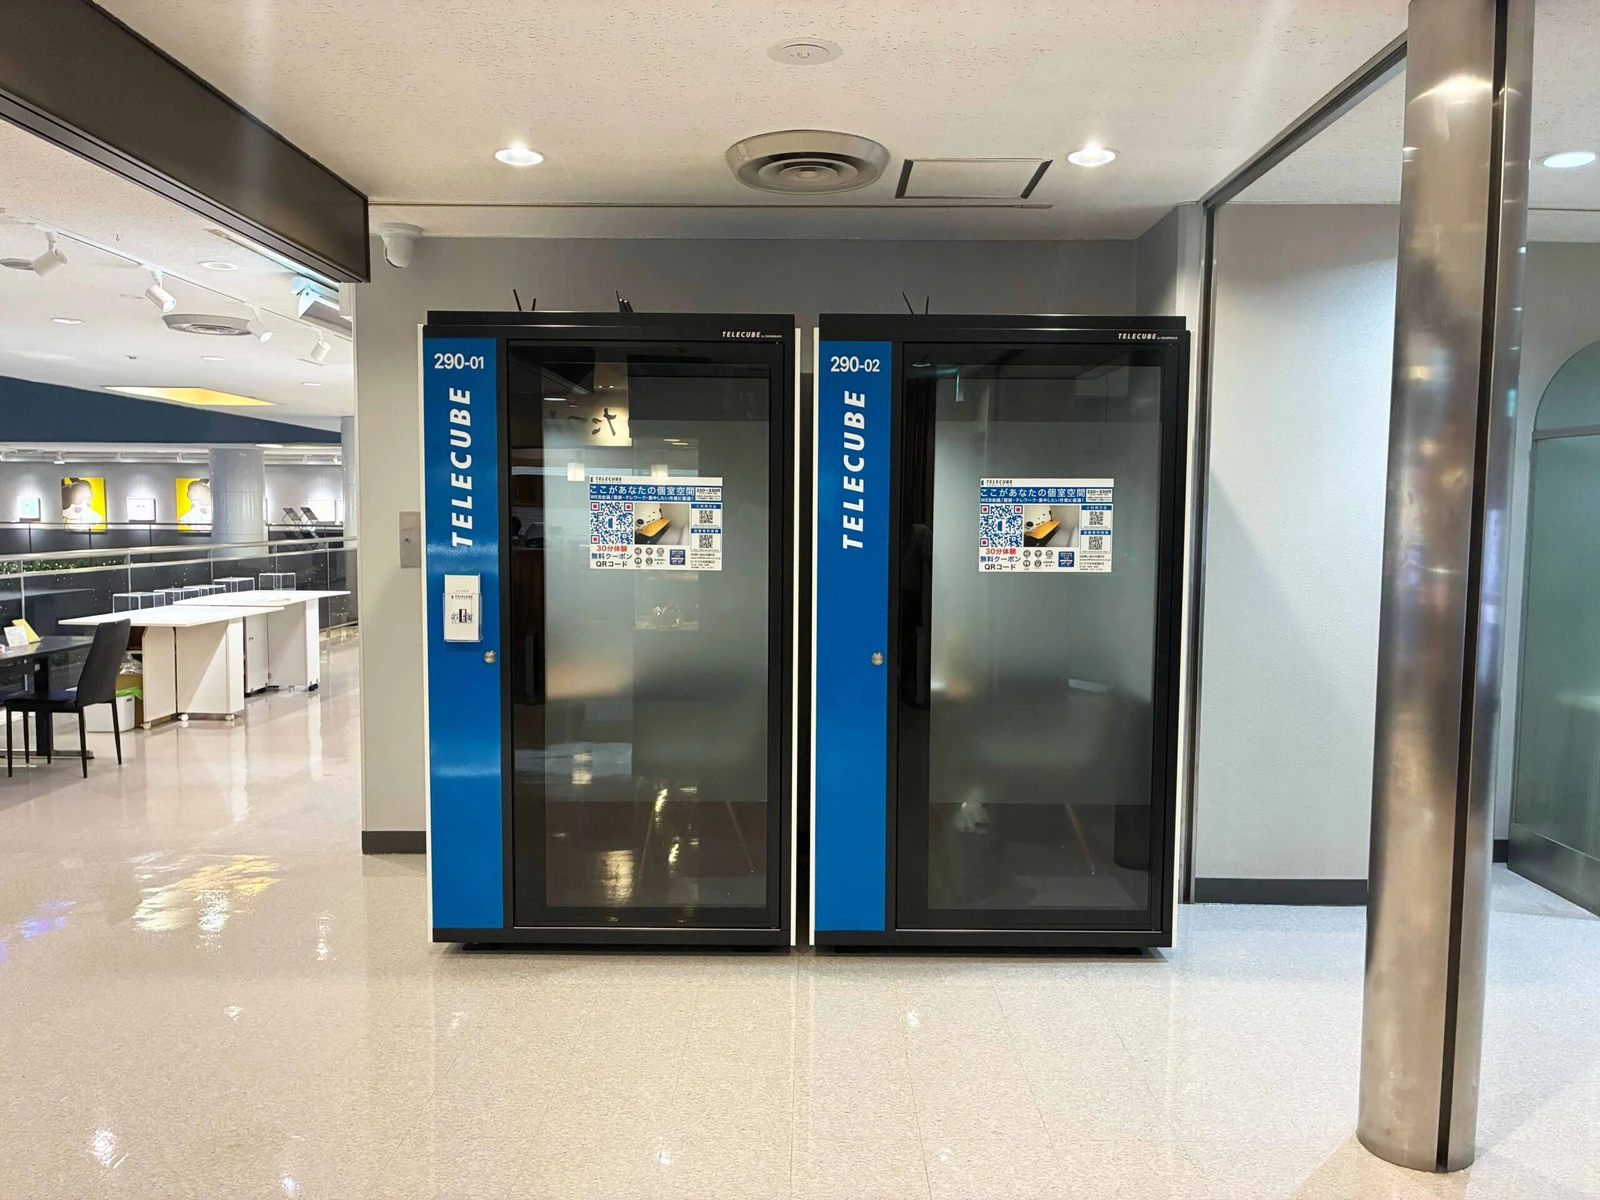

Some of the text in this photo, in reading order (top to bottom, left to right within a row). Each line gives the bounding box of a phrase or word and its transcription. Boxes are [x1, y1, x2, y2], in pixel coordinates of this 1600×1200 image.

[434, 352, 485, 370] 290-01
[830, 355, 881, 373] 290-02
[449, 387, 473, 547] TELECUBE
[842, 390, 866, 549] TELECUBE
[590, 485, 695, 496] ここがあなたの個室空間
[980, 488, 1086, 498] ここがあなたの個室空間
[591, 552, 633, 560] 無料クーポン
[979, 555, 1021, 563] 無料クーポン
[595, 560, 628, 568] QRコード
[984, 563, 1017, 571] QRコード
